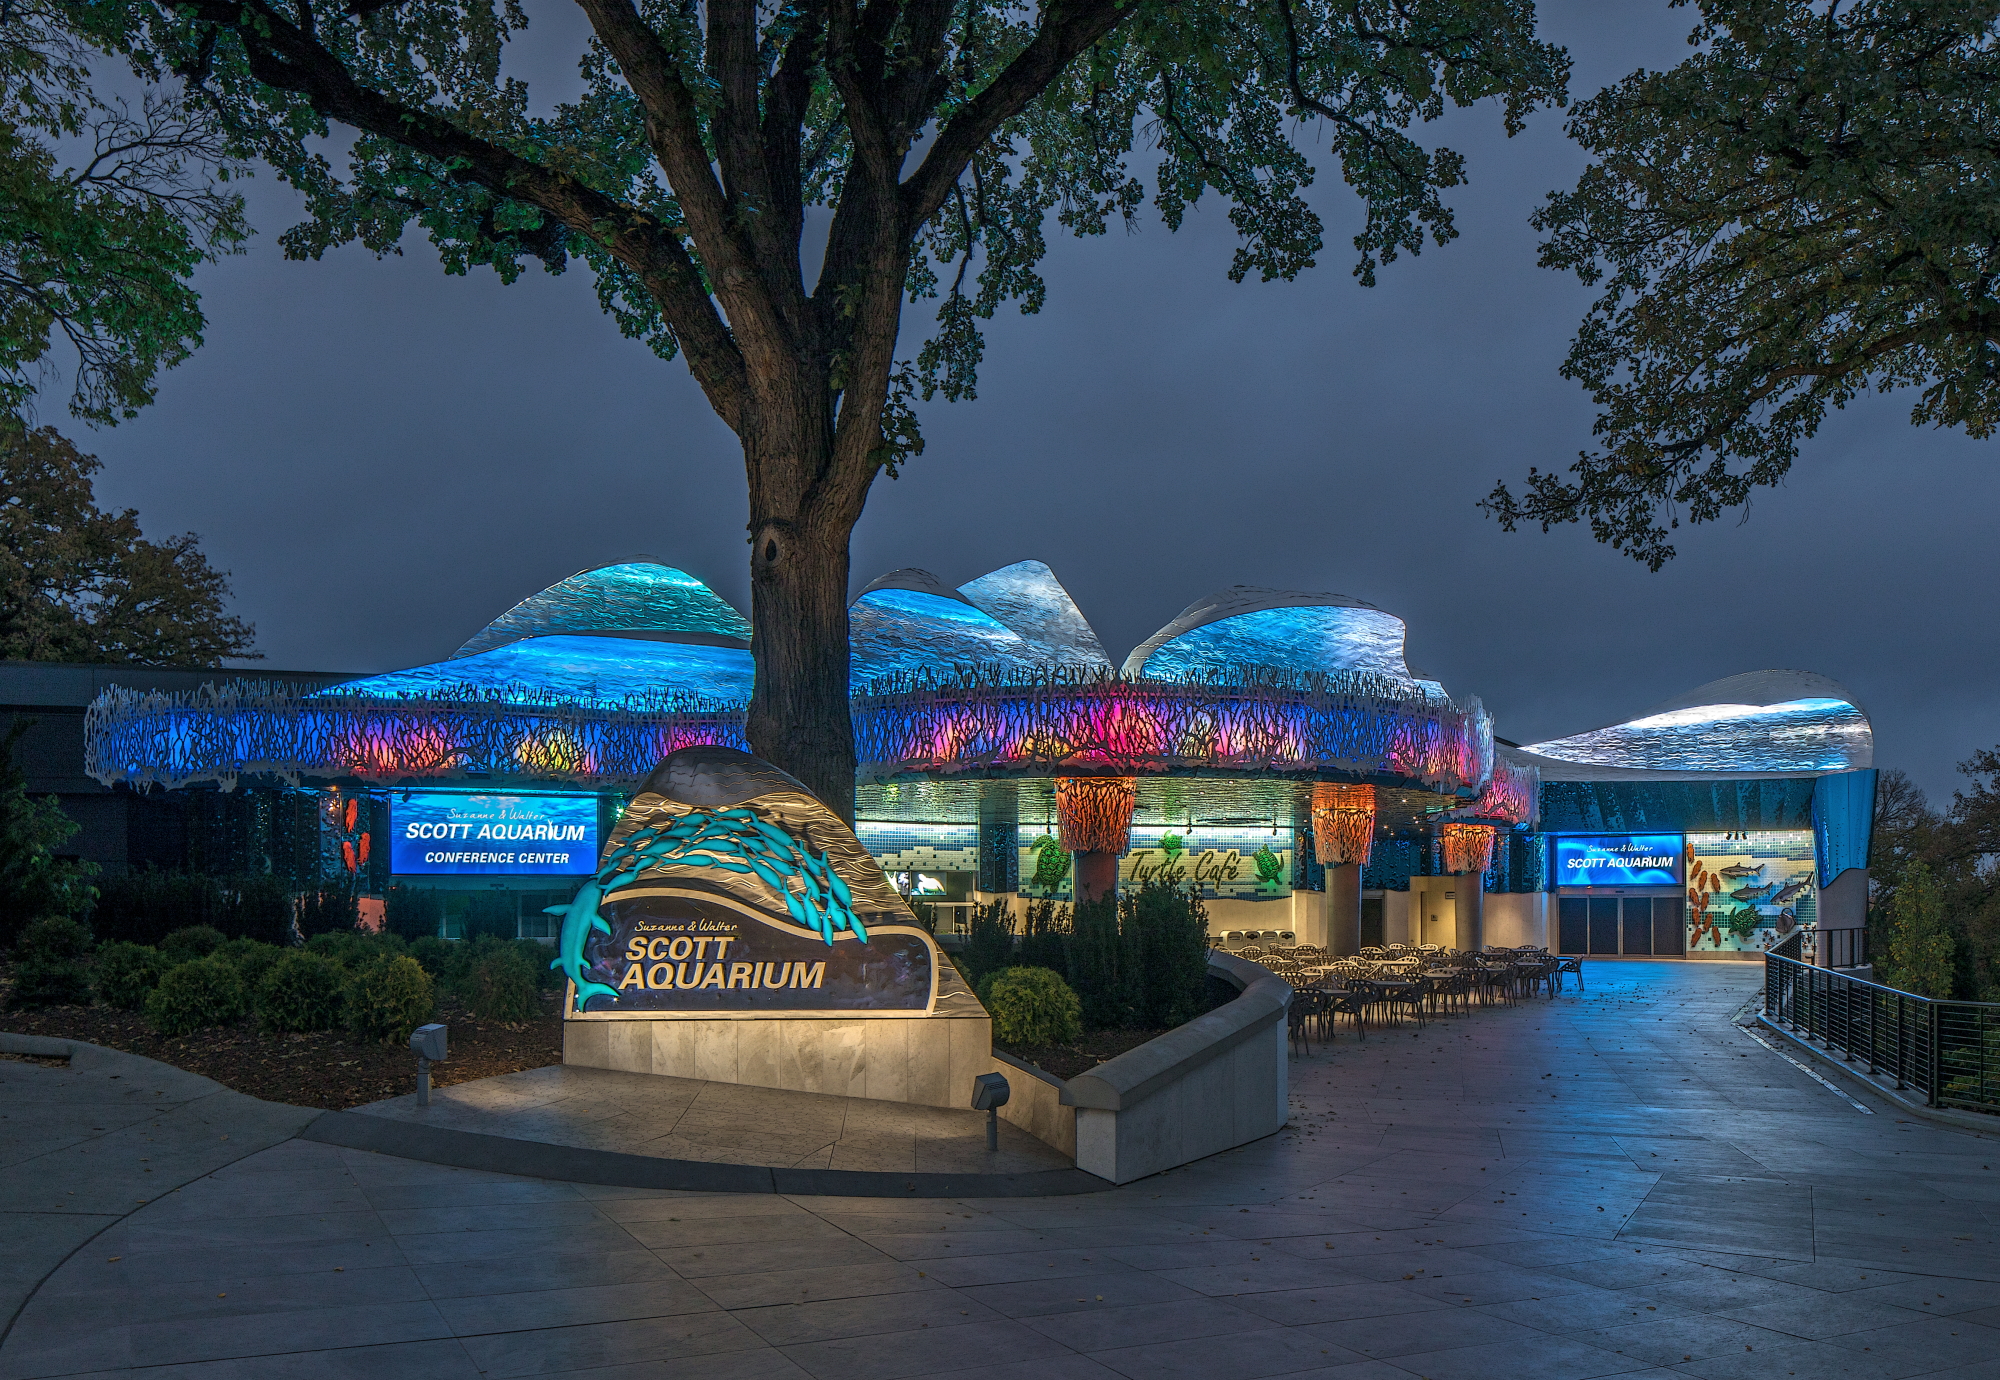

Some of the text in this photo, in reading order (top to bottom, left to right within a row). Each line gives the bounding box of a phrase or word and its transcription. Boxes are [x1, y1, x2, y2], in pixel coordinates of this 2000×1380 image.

[446, 807, 546, 820] Suzanne & Walter
[405, 820, 585, 840] SCOTT AQUARIUM
[1627, 843, 1653, 852] Walter
[425, 852, 570, 864] CONFERENCE CENTER
[1567, 856, 1673, 868] SCOTT AQUARIUM
[1129, 850, 1241, 890] Turtle Café
[634, 917, 738, 932] Suzanne & Walter
[625, 936, 735, 961] SCOTT
[618, 961, 826, 990] AQUARIUM
